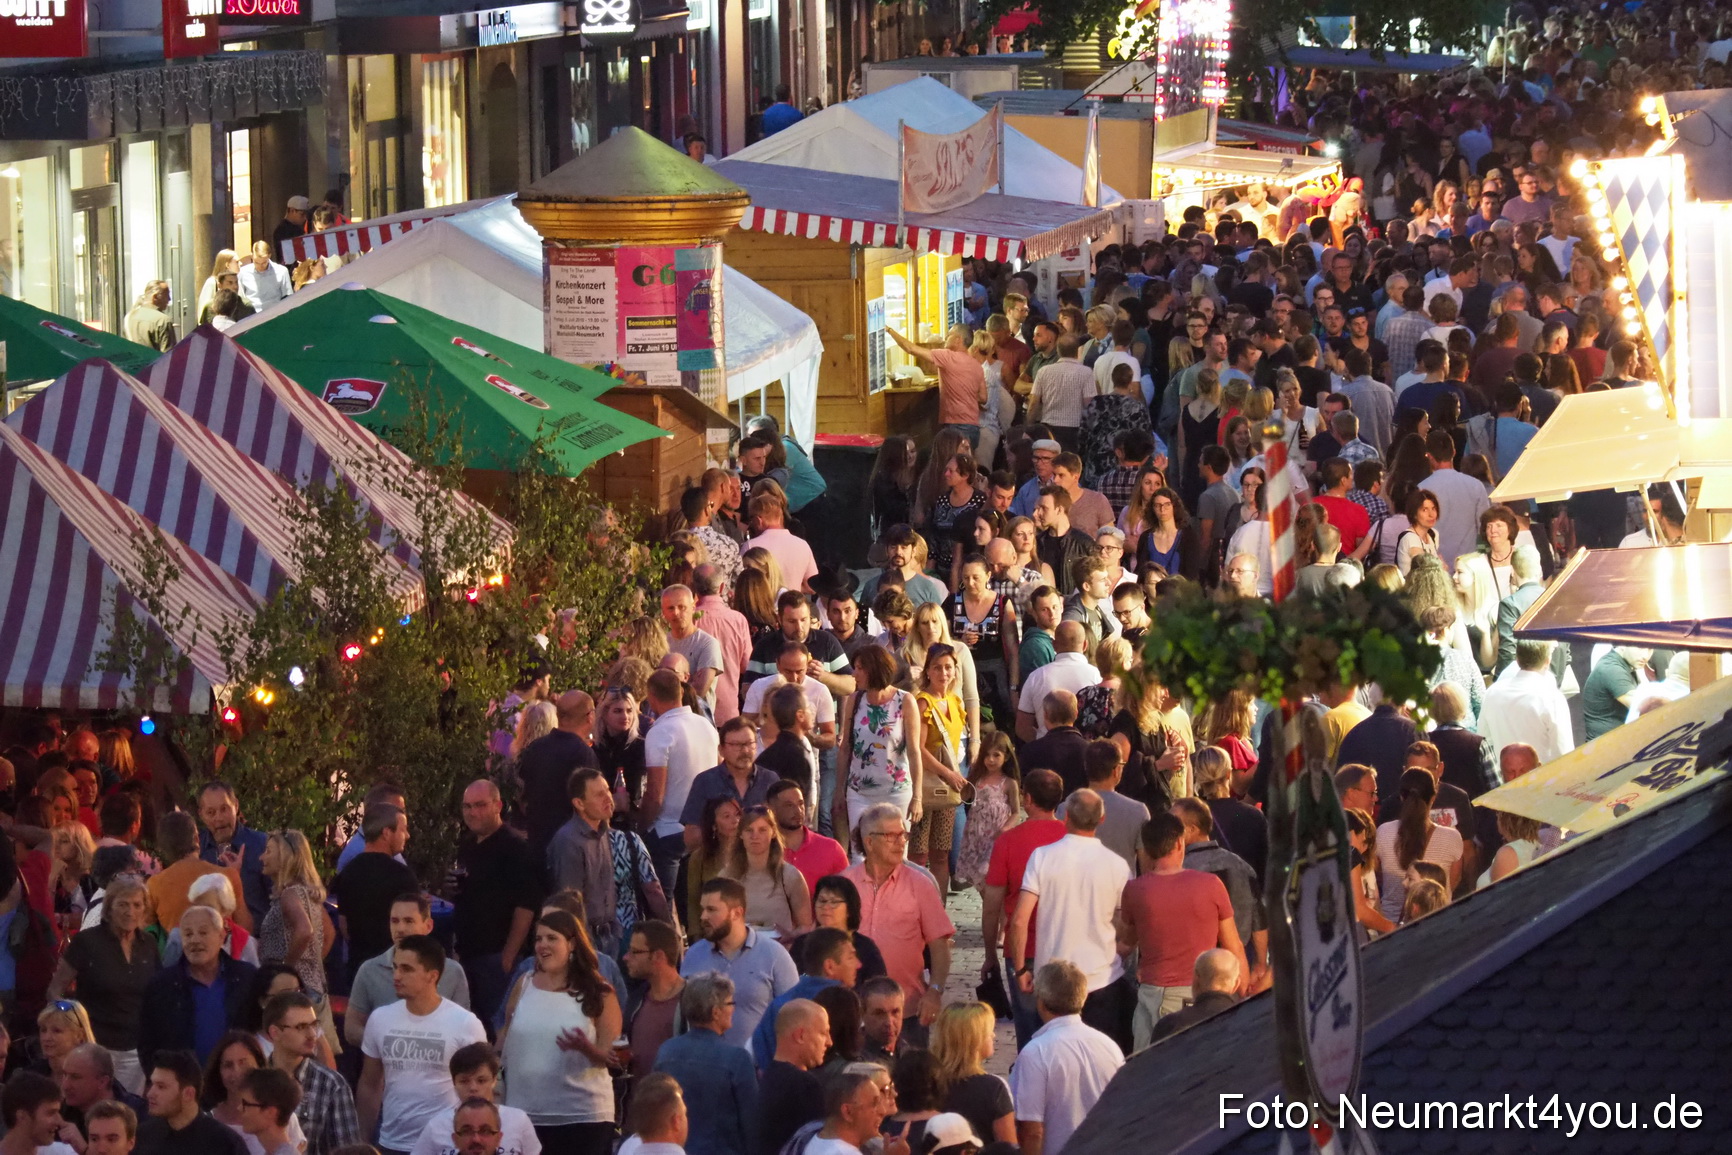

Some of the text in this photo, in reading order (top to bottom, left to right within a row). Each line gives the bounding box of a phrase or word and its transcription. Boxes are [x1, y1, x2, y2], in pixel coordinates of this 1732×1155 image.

[15, 17, 53, 26] weiden
[1263, 145, 1297, 154] POPCORN
[555, 281, 606, 290] Kirchenkonzert
[556, 295, 605, 306] Gospel & More
[628, 319, 664, 327] Sommernacht
[646, 344, 660, 352] Juni
